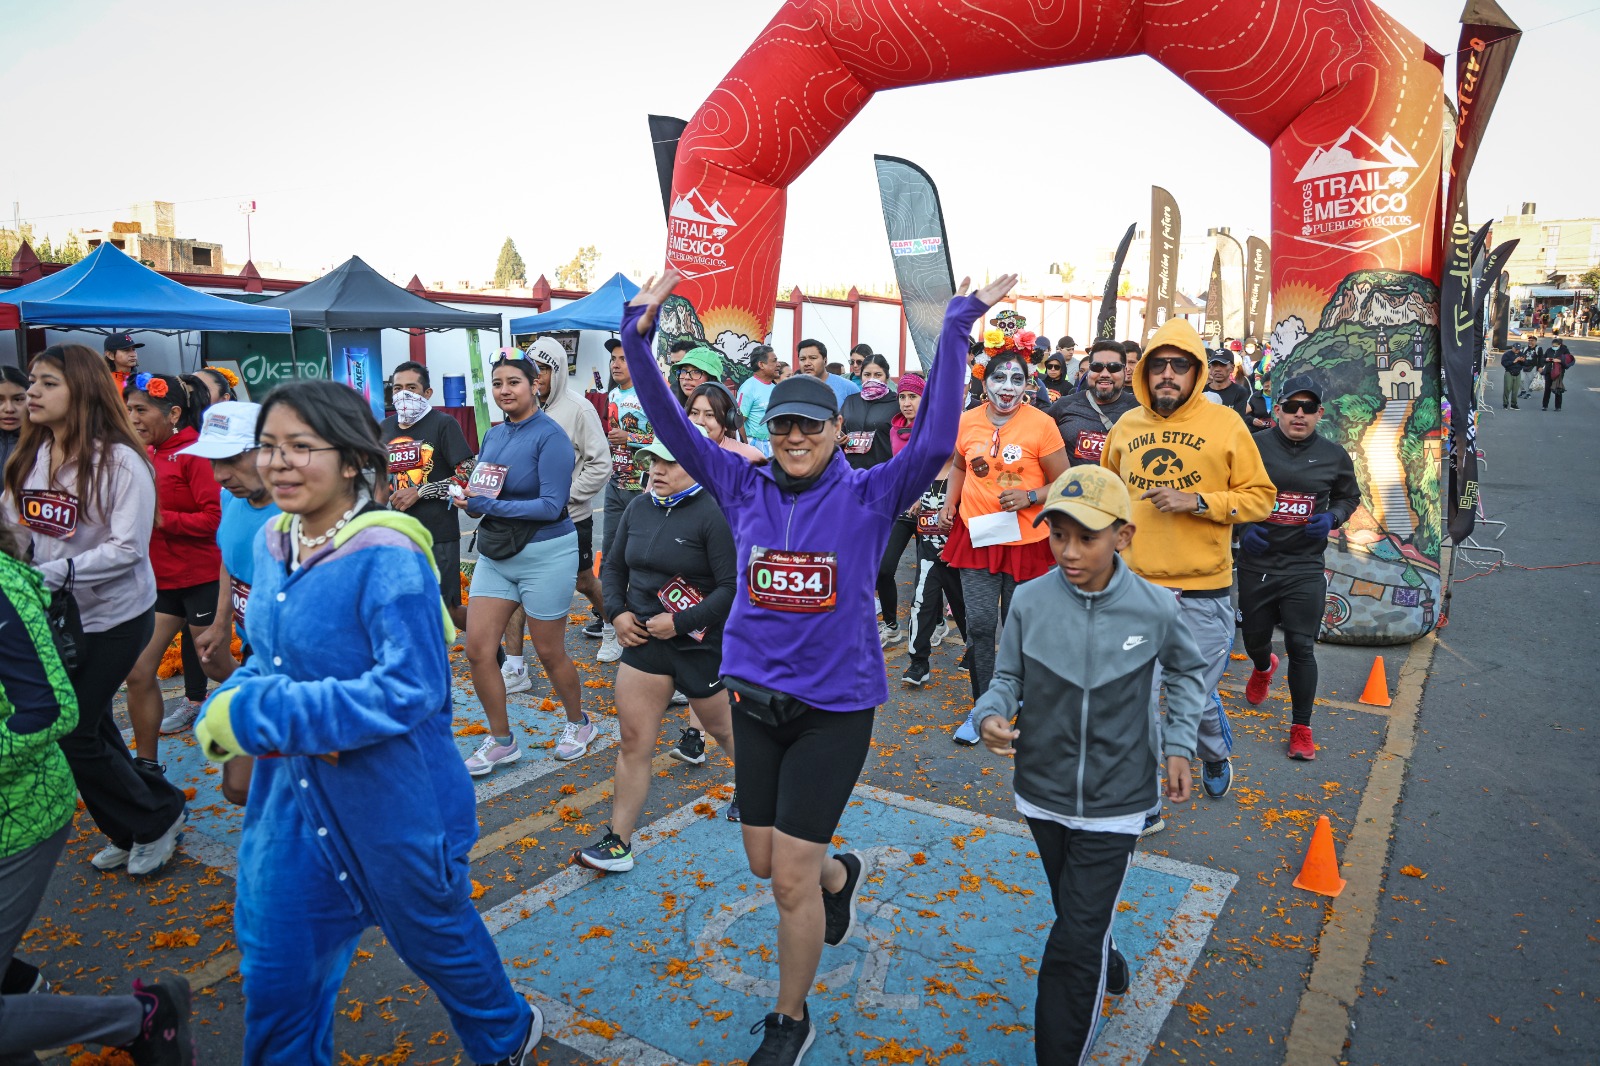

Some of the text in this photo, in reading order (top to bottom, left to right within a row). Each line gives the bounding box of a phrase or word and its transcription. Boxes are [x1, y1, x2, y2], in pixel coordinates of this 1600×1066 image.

[1314, 171, 1389, 199] TRAIL
[1302, 182, 1313, 224] FROGS
[1314, 192, 1407, 222] MÉXICO
[674, 219, 713, 239] TRAIL
[672, 234, 725, 257] MÉXICO
[355, 361, 364, 391] AKER
[1082, 439, 1106, 452] 079
[1127, 430, 1206, 453] IOWA STYLE
[389, 450, 416, 463] 0835
[472, 472, 499, 487] 0415
[28, 500, 71, 525] 0611
[920, 516, 939, 526] 08
[756, 568, 823, 593] 0534
[233, 593, 248, 614] 09
[668, 588, 697, 611] 05
